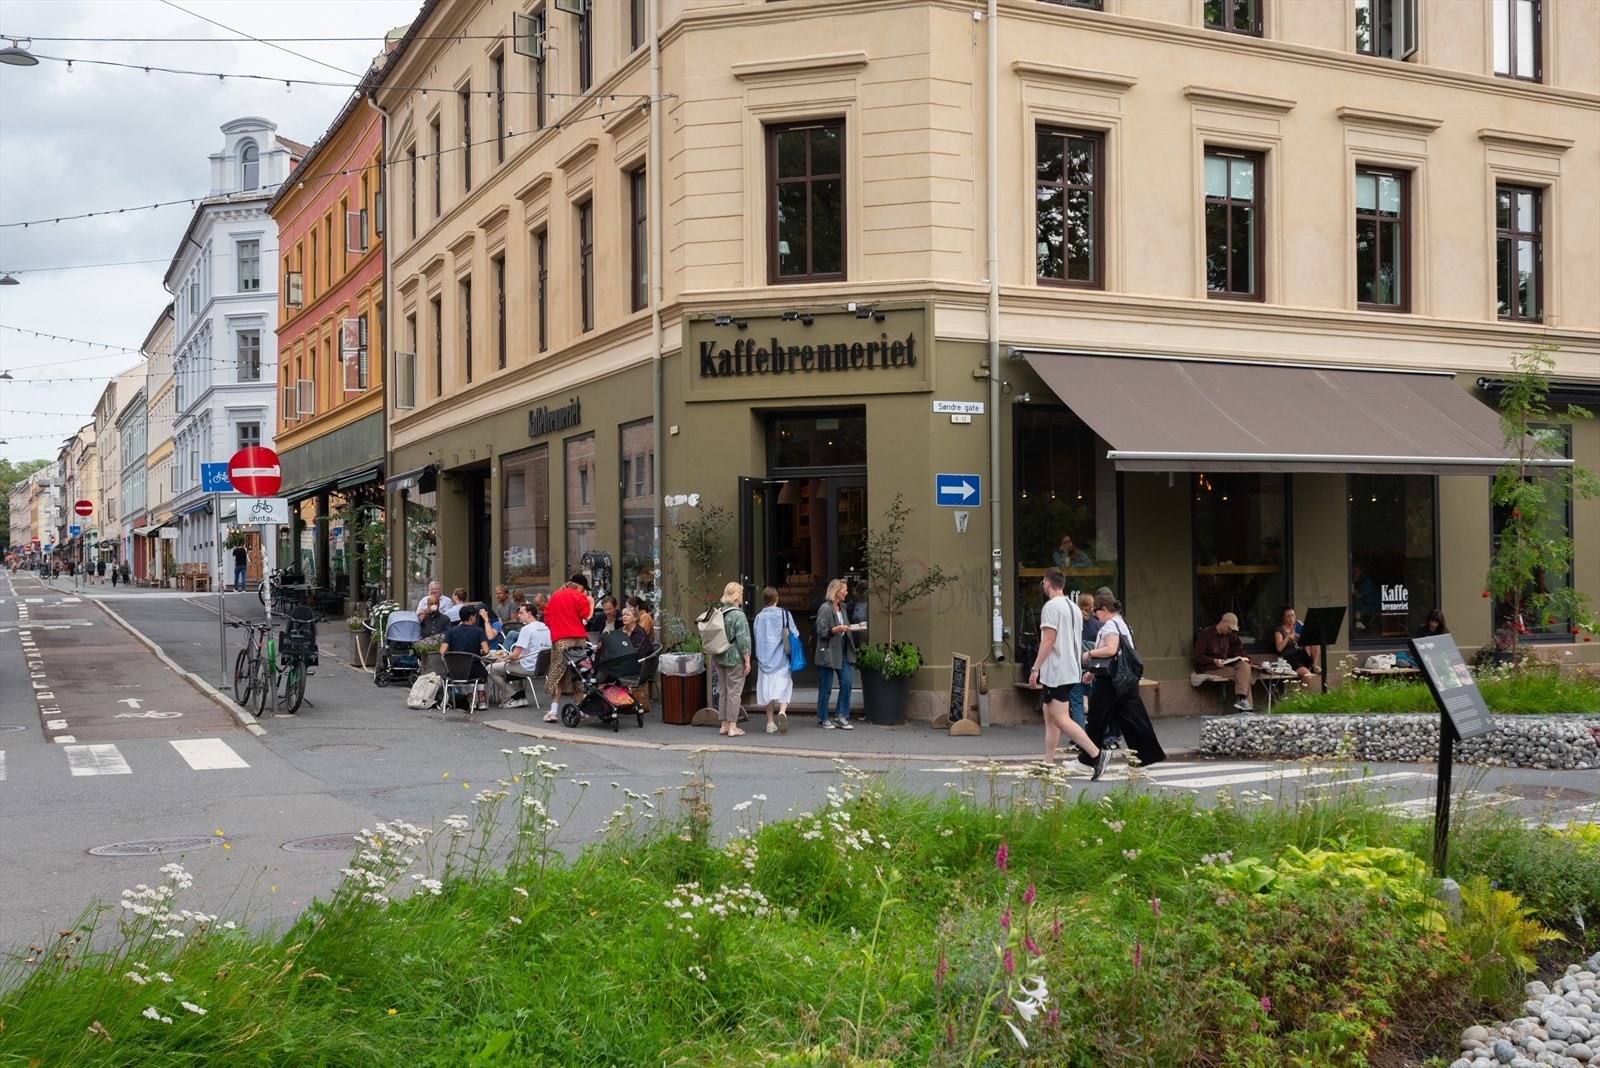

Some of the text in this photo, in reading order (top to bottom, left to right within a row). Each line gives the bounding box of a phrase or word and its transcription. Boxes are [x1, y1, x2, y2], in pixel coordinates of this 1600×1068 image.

[699, 331, 917, 377] Kaffebrenneriet
[938, 403, 979, 412] Søndre gate
[1381, 584, 1408, 602] Kaffe
[1381, 602, 1408, 611] brenneriet
